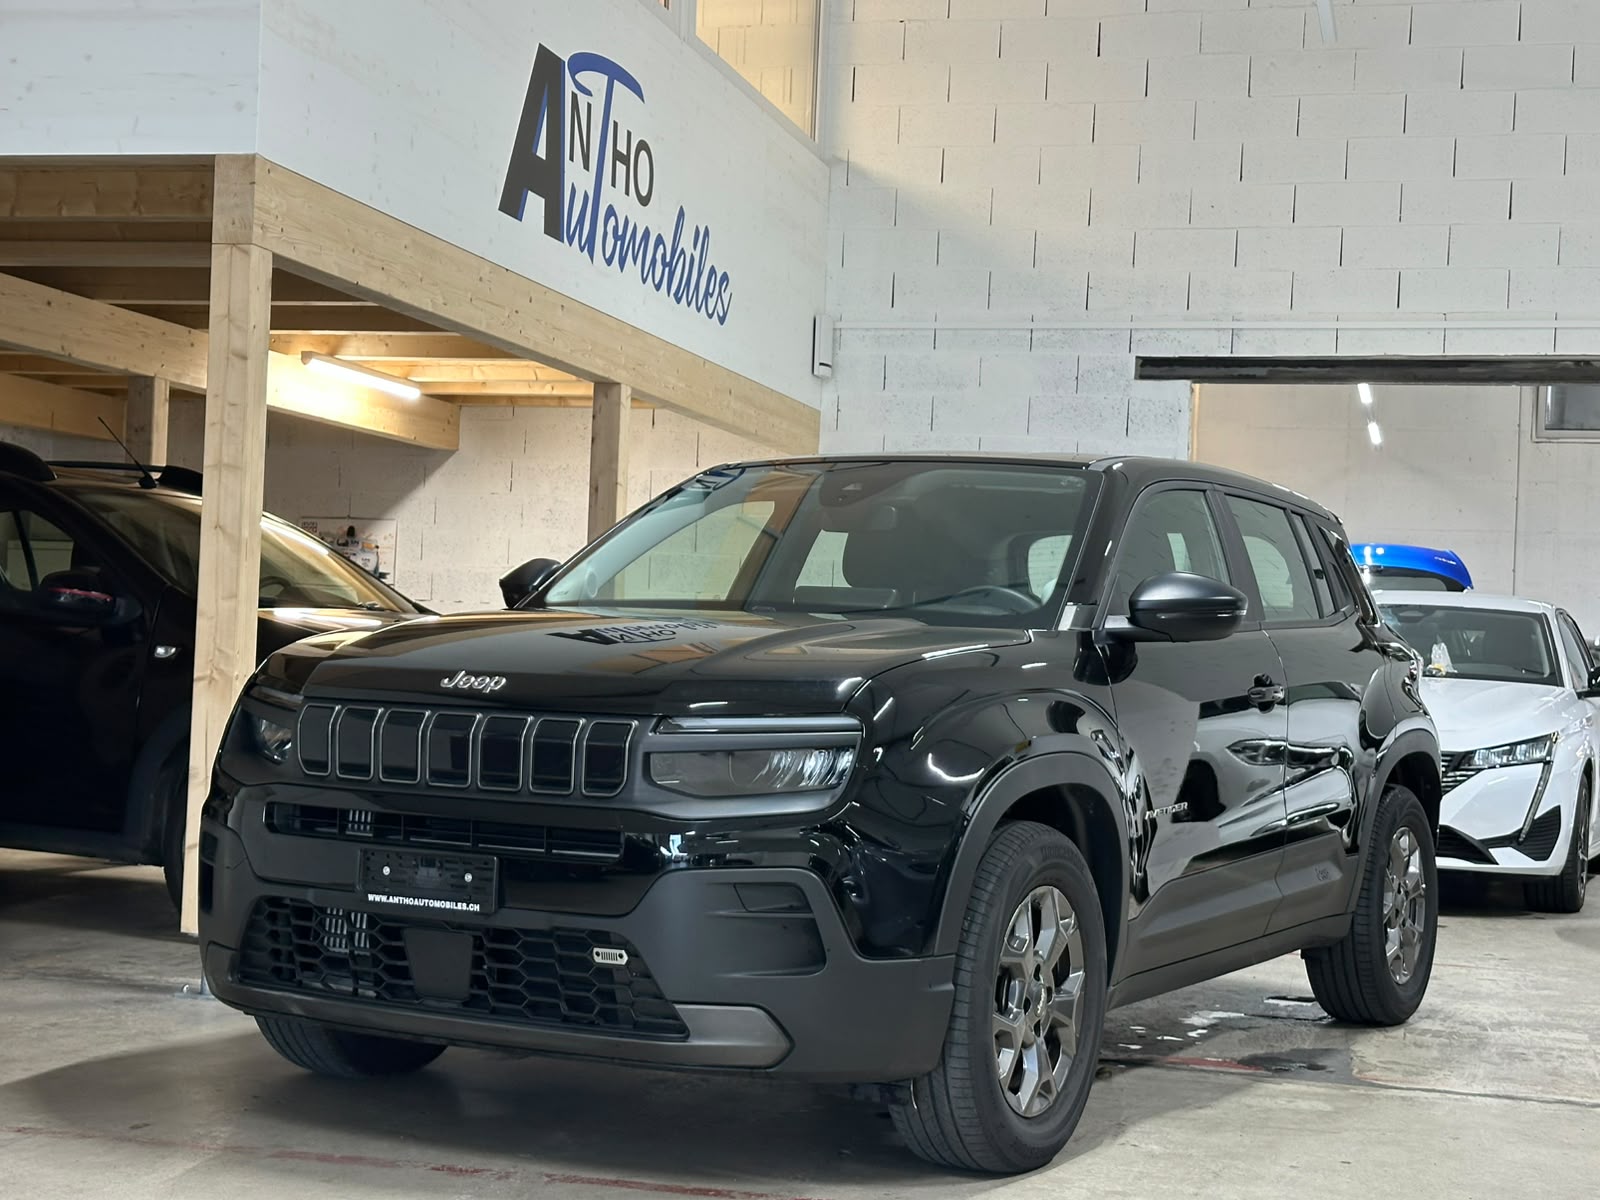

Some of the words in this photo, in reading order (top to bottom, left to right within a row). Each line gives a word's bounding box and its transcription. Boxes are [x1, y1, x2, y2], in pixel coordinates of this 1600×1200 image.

[440, 670, 507, 693] Jeep
[1144, 801, 1188, 820] AVENGER
[367, 893, 480, 911] WWW.ANTHOAUTOMOBILES.CH
